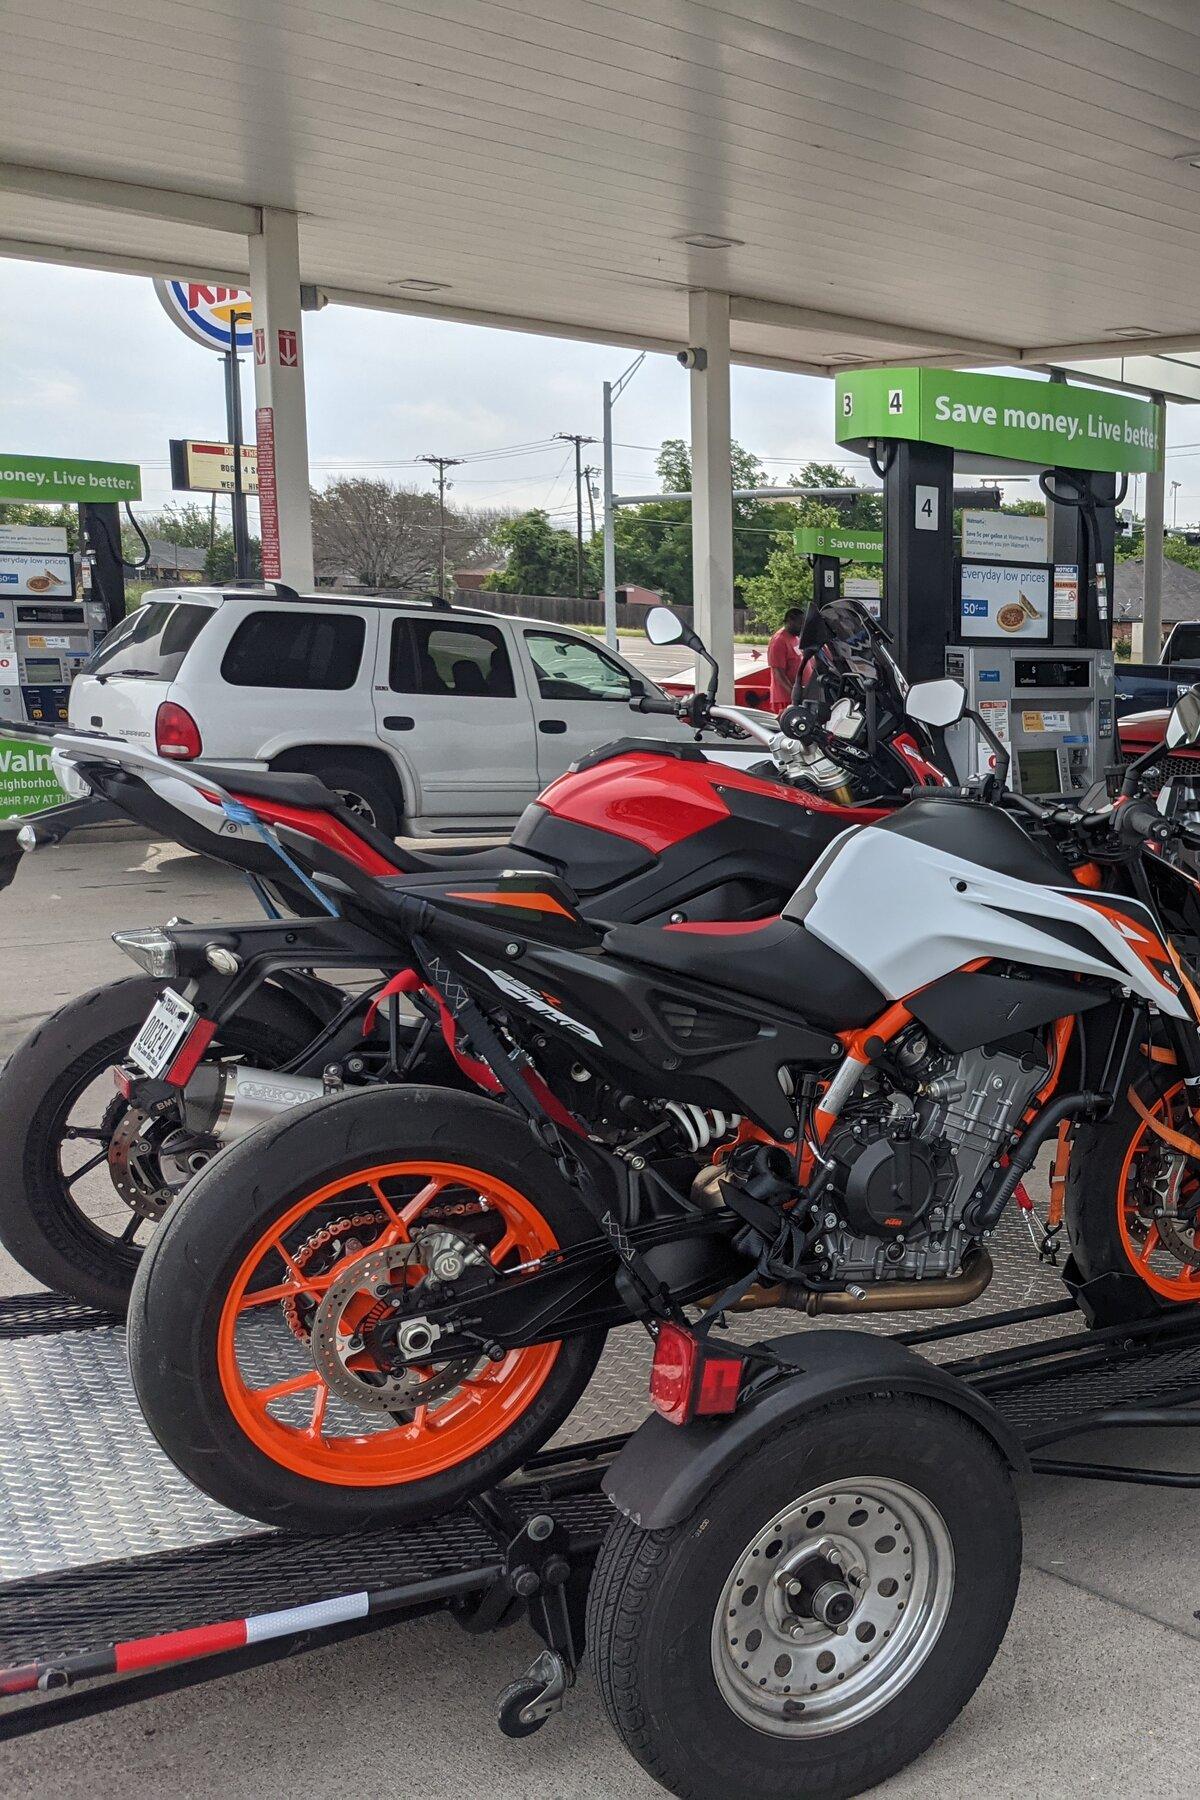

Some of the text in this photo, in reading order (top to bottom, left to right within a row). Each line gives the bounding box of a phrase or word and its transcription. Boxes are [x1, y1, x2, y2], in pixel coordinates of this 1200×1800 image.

[844, 395, 852, 415] 3
[889, 392, 901, 413] 4
[935, 396, 997, 425] Save
[1004, 407, 1083, 440] money.
[1088, 414, 1121, 441] Live
[54, 470, 86, 486] Live
[89, 473, 134, 490] better.
[921, 498, 933, 518] 4
[830, 538, 854, 549] Save
[962, 567, 1001, 583] Everyday
[1003, 569, 1018, 582] low
[1021, 571, 1046, 585] prices
[23, 795, 40, 805] PAY
[42, 794, 55, 804] AT
[157, 1096, 177, 1111] BMW
